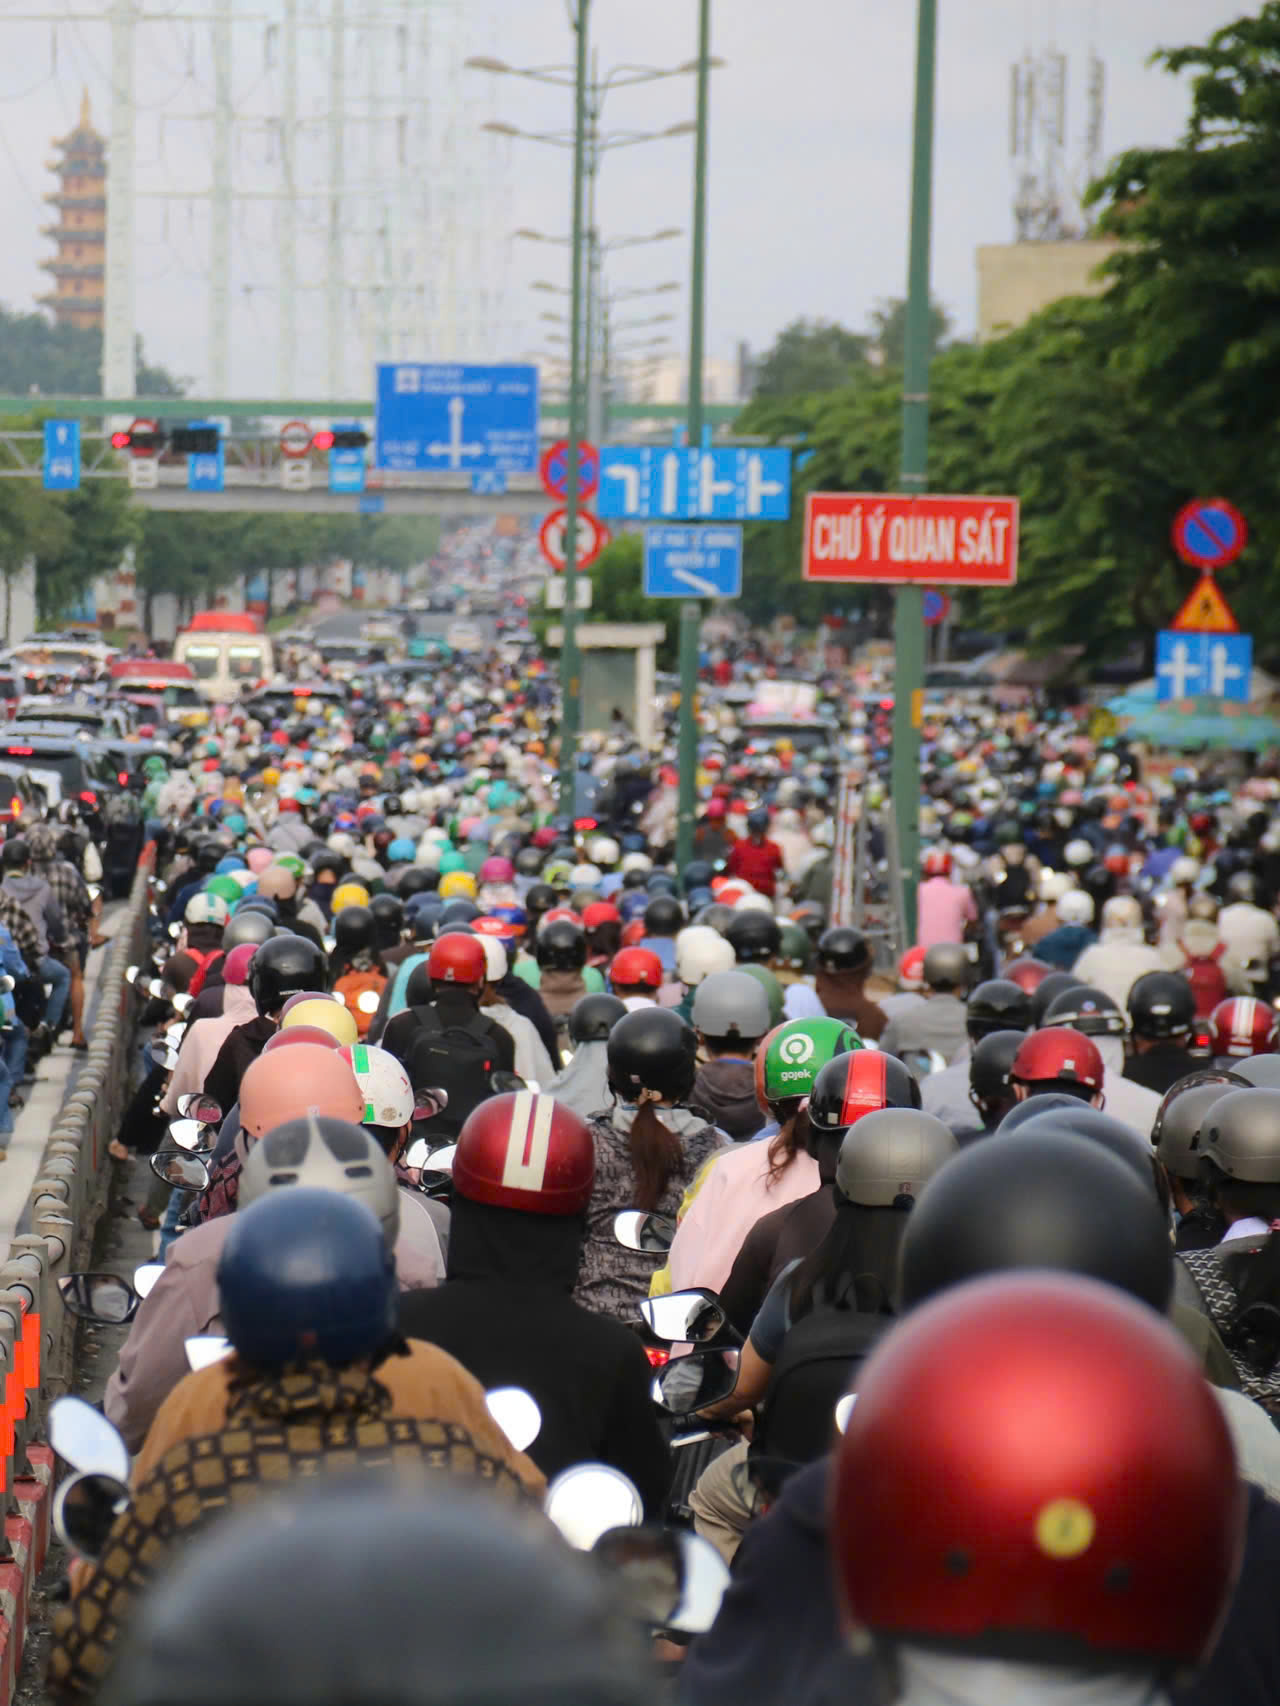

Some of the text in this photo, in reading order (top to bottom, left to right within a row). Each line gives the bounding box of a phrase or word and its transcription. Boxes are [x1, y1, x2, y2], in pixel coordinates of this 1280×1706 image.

[813, 504, 1010, 566] CHÚ Ý QUAN SÁT
[781, 1069, 812, 1082] gojek
